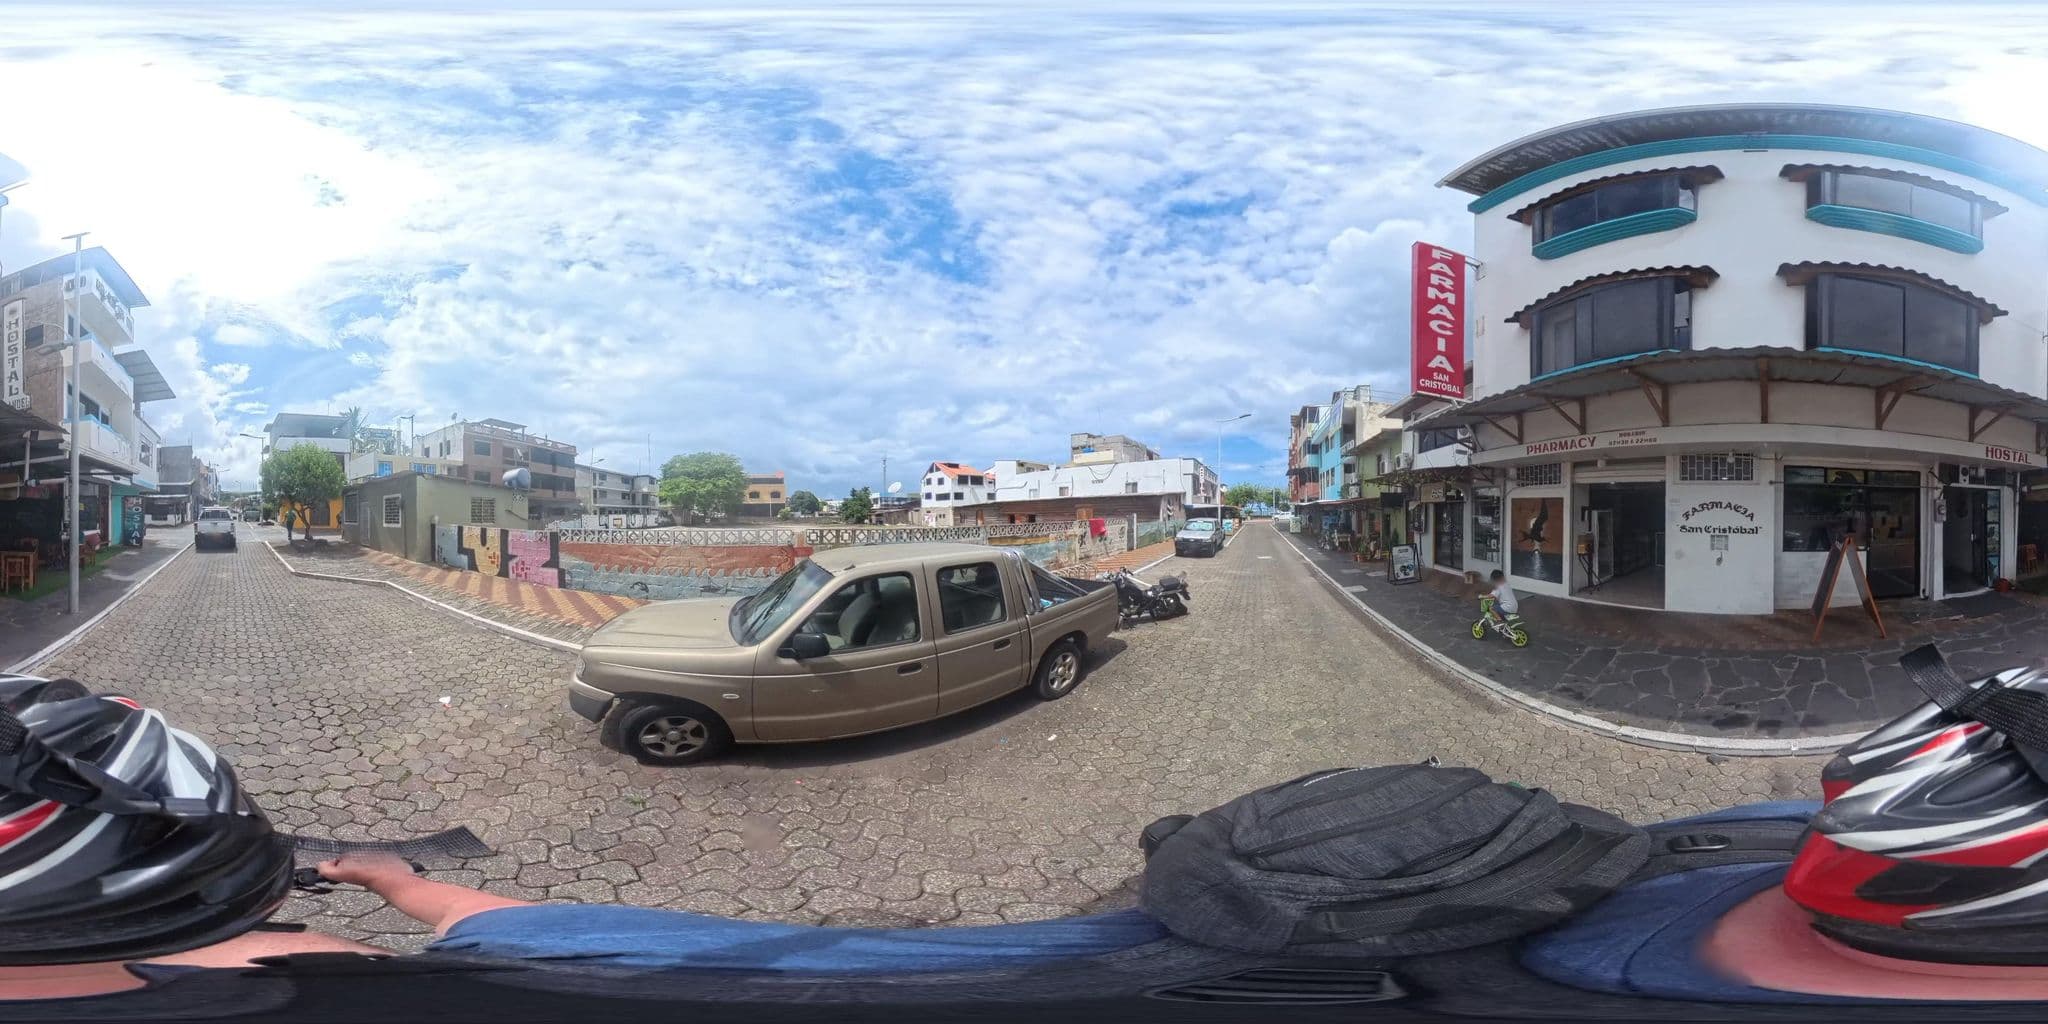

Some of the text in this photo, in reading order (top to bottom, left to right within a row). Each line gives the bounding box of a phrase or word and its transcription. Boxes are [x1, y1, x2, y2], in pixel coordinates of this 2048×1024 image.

[1427, 248, 1456, 373] FARMACIA
[7, 317, 20, 397] HOSTAL
[1419, 378, 1462, 394] CRISTOBAL
[1433, 372, 1450, 382] SAN
[1526, 436, 1598, 456] PHARMACY
[1985, 446, 2032, 465] HOSTAL
[1682, 501, 1755, 521] FARMACIA
[132, 497, 142, 546] HOSTAL
